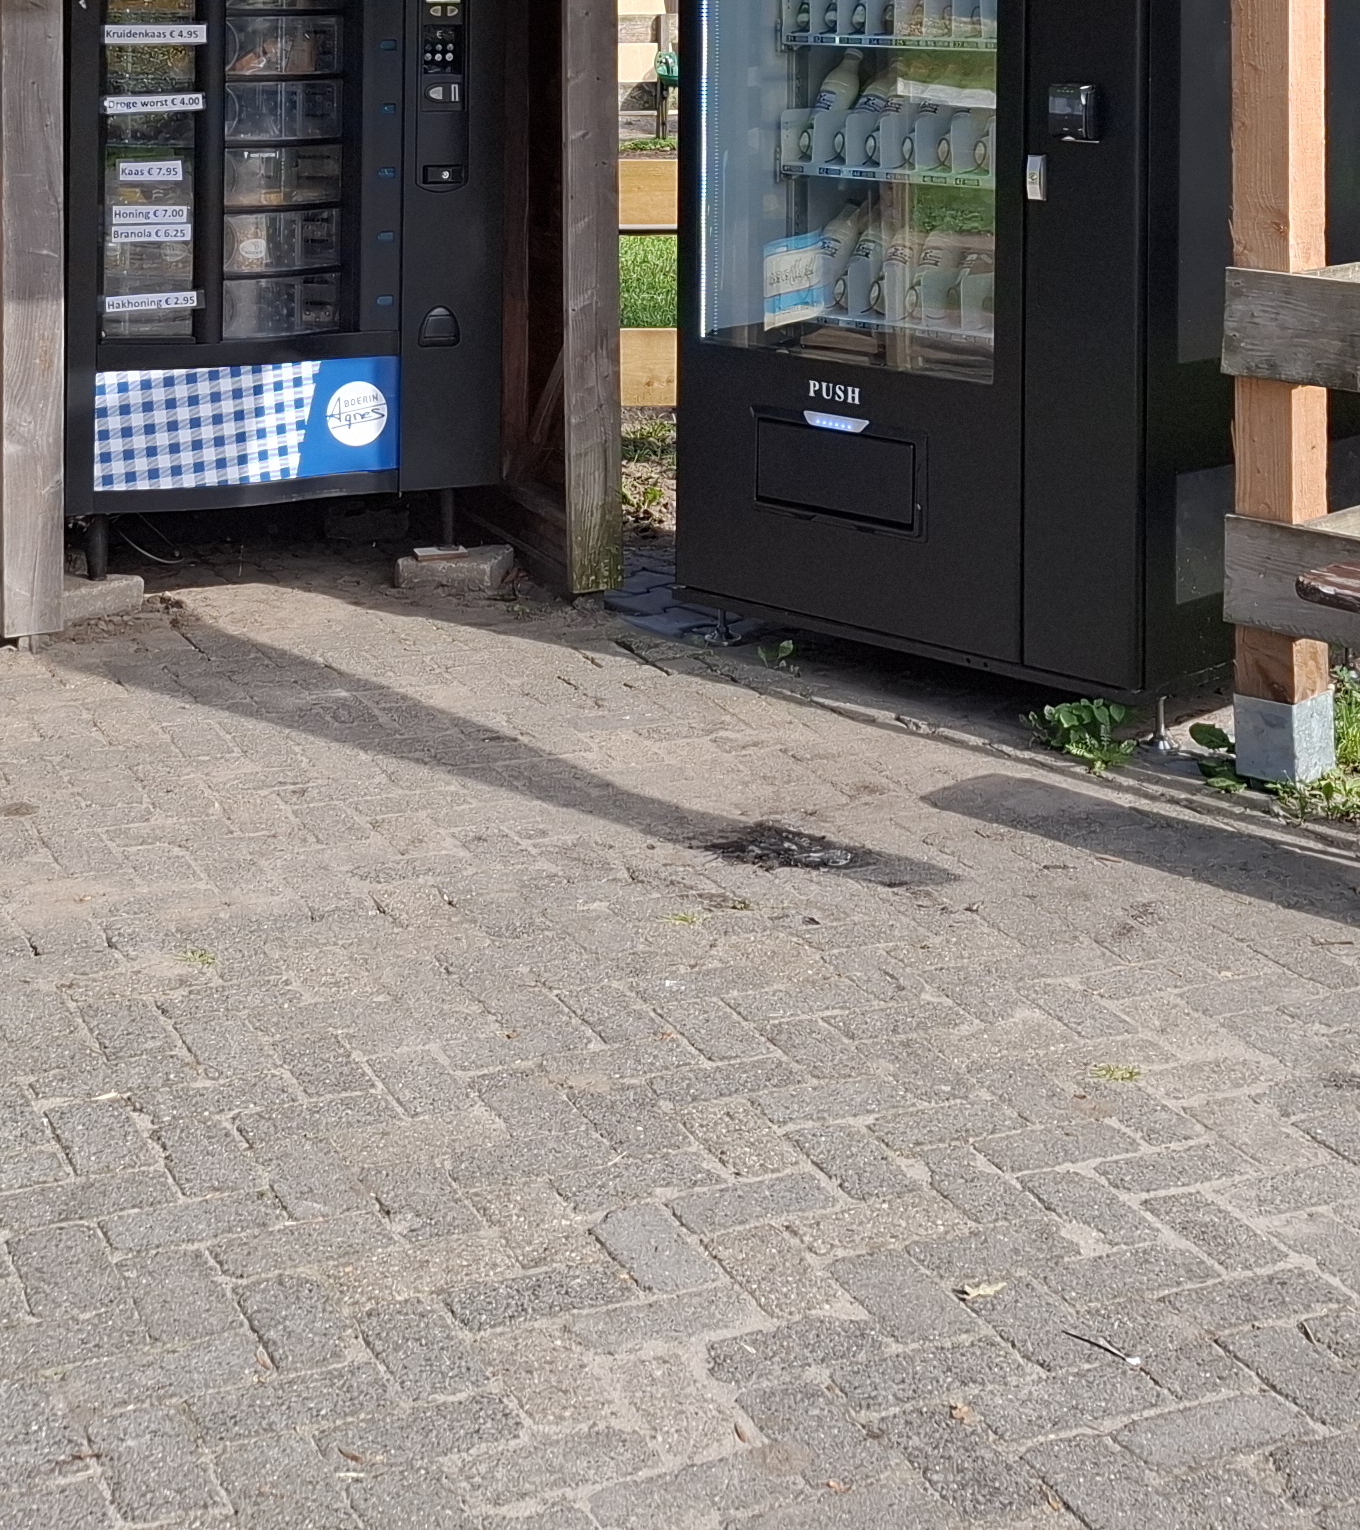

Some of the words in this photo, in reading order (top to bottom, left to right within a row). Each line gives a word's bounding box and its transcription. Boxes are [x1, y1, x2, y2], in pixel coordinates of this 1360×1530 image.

[105, 29, 167, 39] Kruidenkaas
[177, 29, 199, 39] 4.95
[108, 100, 138, 109] Droge
[140, 98, 168, 108] worst
[179, 96, 200, 106] 4.00
[121, 167, 144, 176] Kaas
[157, 167, 178, 176] 7.95
[114, 209, 151, 220] Honing
[162, 209, 184, 218] 7.00
[113, 229, 152, 239] Branola
[164, 229, 186, 238] 6.25
[173, 296, 195, 306] 2.95
[808, 379, 861, 405] PUSH
[343, 393, 379, 408] BOERIN
